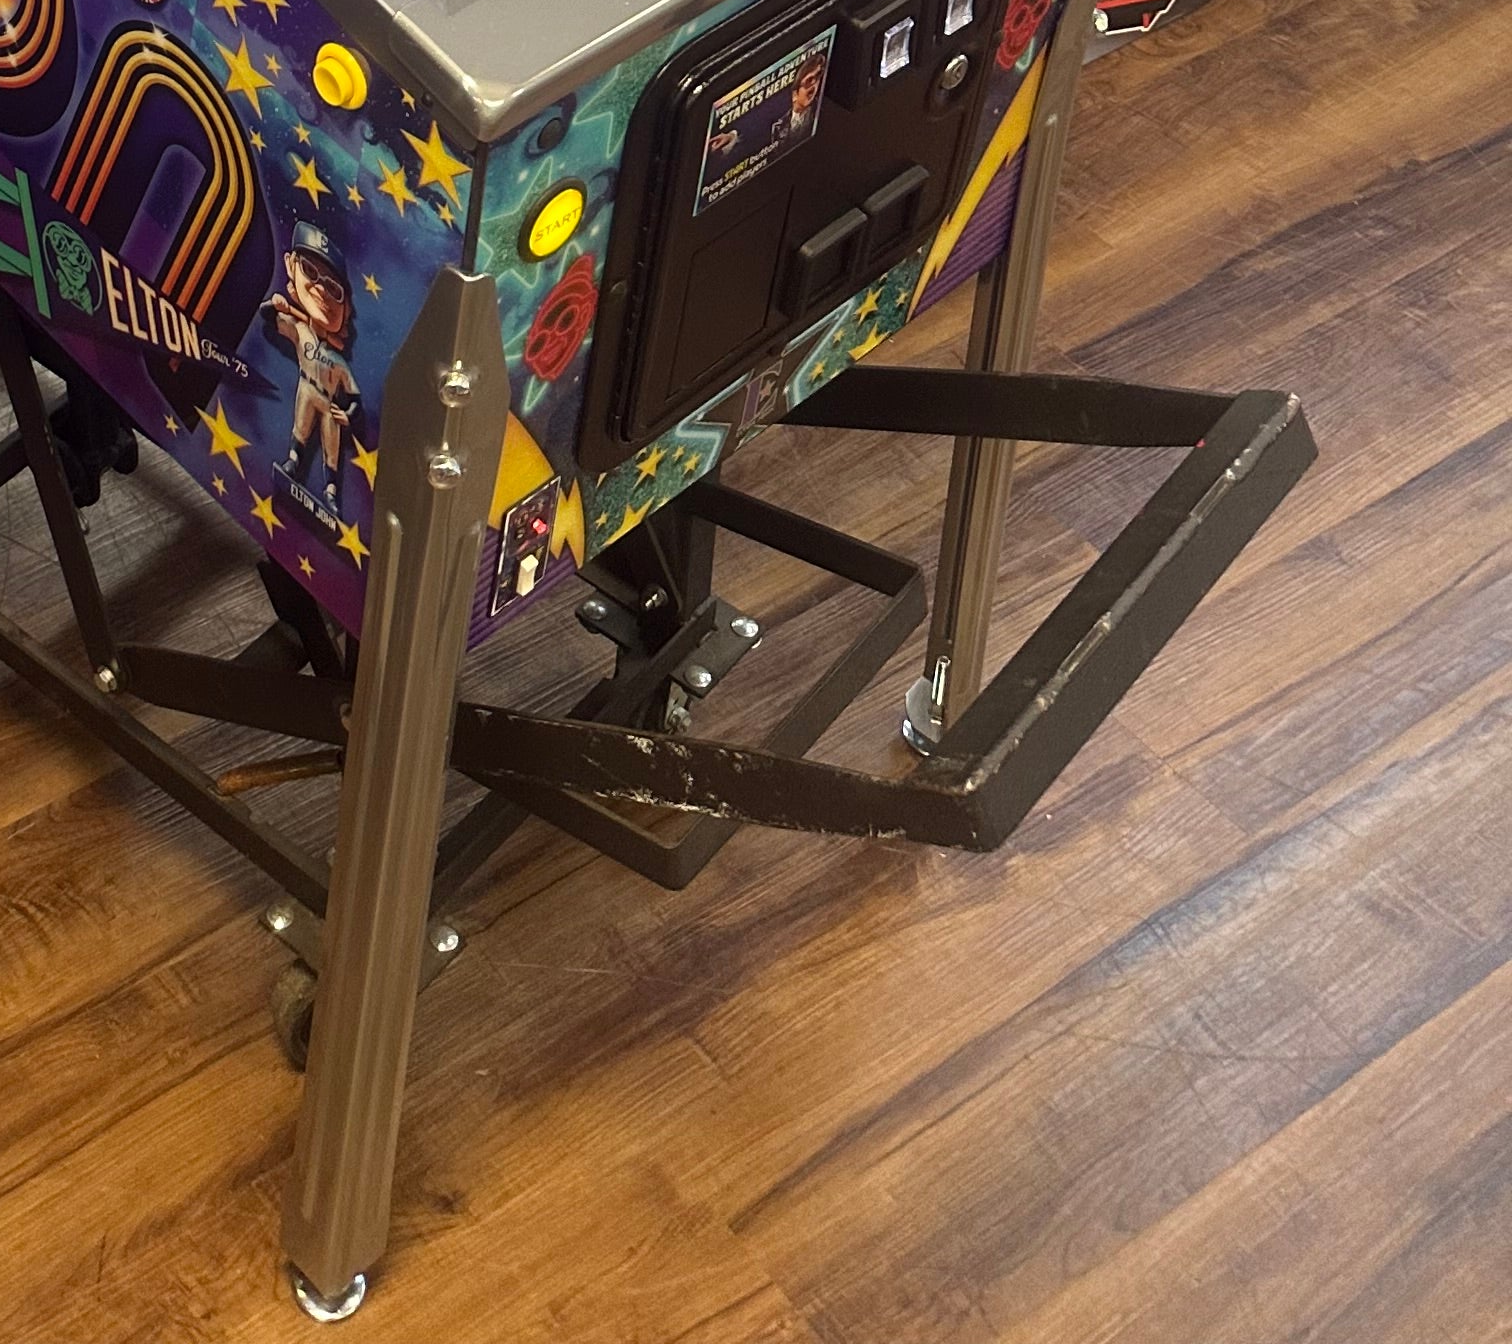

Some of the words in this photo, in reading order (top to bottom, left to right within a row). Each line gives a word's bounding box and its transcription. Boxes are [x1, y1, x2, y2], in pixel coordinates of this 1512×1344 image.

[716, 96, 739, 118] YOUR
[739, 72, 777, 102] PINBALL
[777, 37, 829, 79] ADVENTURE
[719, 91, 764, 130] STARTS
[764, 69, 797, 100] HERE
[701, 176, 723, 197] Press
[724, 157, 749, 181] START
[749, 141, 779, 163] button
[708, 189, 718, 202] to
[719, 178, 737, 196] add
[736, 157, 768, 186] players
[535, 206, 582, 243] START
[100, 247, 202, 361] ELTON
[201, 338, 231, 368] Tour
[231, 356, 249, 377] '75
[303, 341, 336, 368] Elton
[290, 485, 315, 513] ELTON
[315, 506, 337, 532] JOHN
